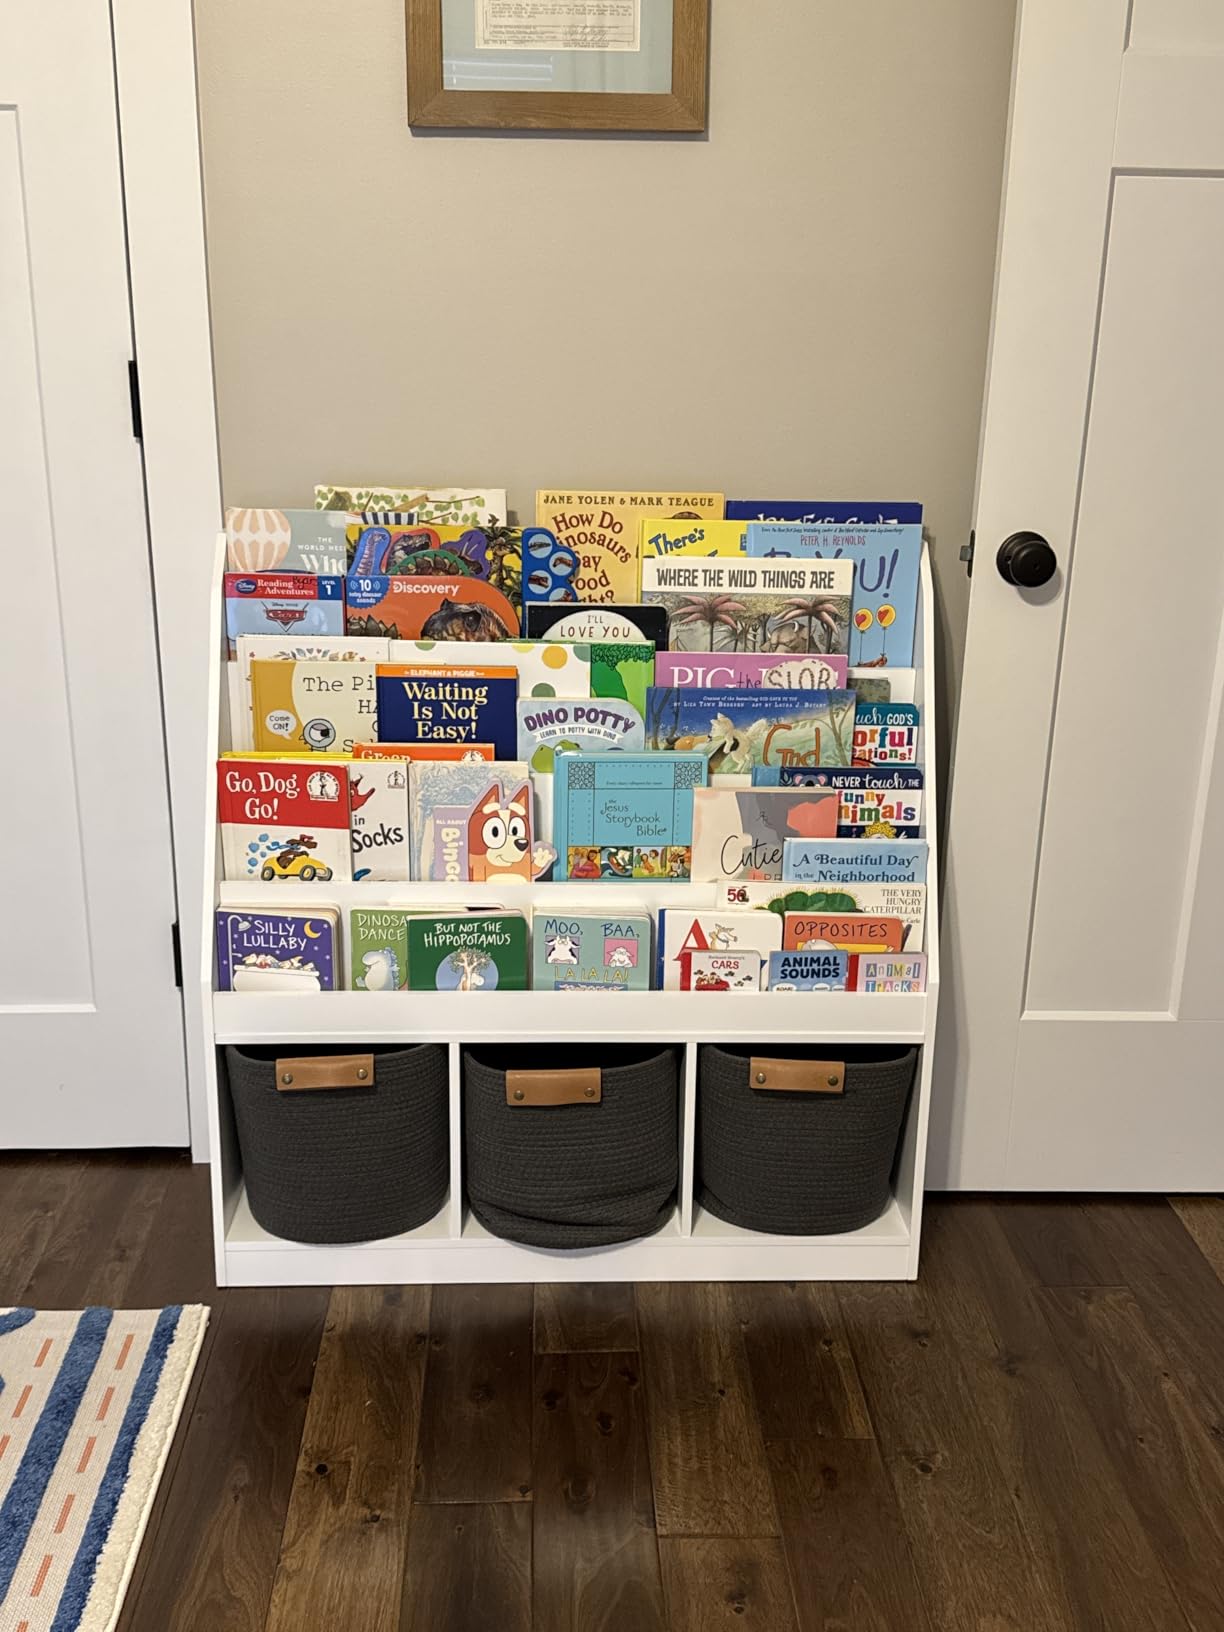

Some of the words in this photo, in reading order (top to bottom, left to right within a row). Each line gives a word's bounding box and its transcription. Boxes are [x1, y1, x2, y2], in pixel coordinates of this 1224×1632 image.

[544, 495, 573, 505] JANE
[577, 495, 615, 505] YOLEN
[619, 495, 626, 505] &
[630, 496, 663, 506] MARK
[668, 497, 714, 507] TEAGUE
[552, 513, 594, 533] How
[598, 511, 624, 534] Do
[556, 531, 632, 564] inosaurs
[648, 528, 705, 555] There's
[800, 535, 819, 546] PETER
[833, 535, 866, 546] REYNOLDS
[574, 551, 602, 572] ay
[258, 579, 293, 588] Reading
[359, 579, 372, 591] 10
[574, 569, 610, 590] ood
[657, 568, 699, 587] WHERE
[702, 569, 724, 587] THE
[728, 569, 757, 588] WILD
[761, 570, 806, 589] THINGS
[809, 570, 835, 589] ARE
[265, 587, 314, 595] Adventures
[326, 585, 332, 595] 1
[393, 581, 460, 596] Discovery
[587, 615, 604, 624] I'LL
[560, 626, 594, 638] LOVE
[603, 626, 630, 638] YOU
[303, 676, 343, 692] The
[669, 666, 737, 688] PIG
[402, 682, 488, 705] Waiting
[412, 701, 433, 719] Is
[441, 701, 479, 720] Not
[856, 708, 886, 725] uch
[886, 713, 913, 725] GOD'S
[273, 722, 289, 732] ON!
[523, 708, 568, 732] DINO
[574, 707, 635, 733] POTTY
[416, 720, 478, 743] Easy!
[540, 730, 556, 739] LEARN
[587, 727, 601, 735] WITH
[603, 731, 617, 740] DINO
[854, 727, 913, 748] orful
[226, 771, 256, 794] Go,
[257, 771, 300, 799] Dog.
[832, 776, 860, 788] NEVER
[863, 772, 907, 789] touch
[908, 778, 919, 787] THE
[837, 790, 885, 806] funny
[245, 798, 279, 820] Go!
[600, 802, 629, 815] Jesus
[839, 802, 915, 823] nimals
[354, 814, 365, 826] in
[606, 811, 661, 828] Storybook
[352, 823, 404, 853] Socks
[637, 824, 667, 836] Bible
[720, 835, 783, 875] Cutie
[793, 854, 810, 867] A
[814, 854, 882, 867] Beautiful
[886, 855, 918, 869] Day
[815, 870, 916, 882] Neighborhood
[881, 889, 899, 897] THE
[900, 889, 921, 897] VERY
[886, 897, 921, 905] HUNGRY
[863, 905, 921, 914] CATERPILLAR
[356, 913, 407, 926] DINOSA
[254, 920, 295, 936] SILLY
[358, 928, 405, 940] DANCE
[434, 922, 456, 935] BUT
[459, 922, 480, 933] NOT
[482, 921, 502, 933] THE
[544, 919, 583, 935] MOO,
[601, 922, 640, 938] BAA,
[794, 921, 888, 938] OPPOSITES
[243, 933, 307, 951] LULLABY
[424, 933, 511, 948] HIPPOPOTAMUS
[712, 960, 740, 970] CARS
[781, 956, 840, 967] ANIMAL
[554, 966, 576, 981] LA
[581, 966, 598, 982] LA
[603, 967, 630, 983] LA!
[780, 967, 840, 979] SOUNDS
